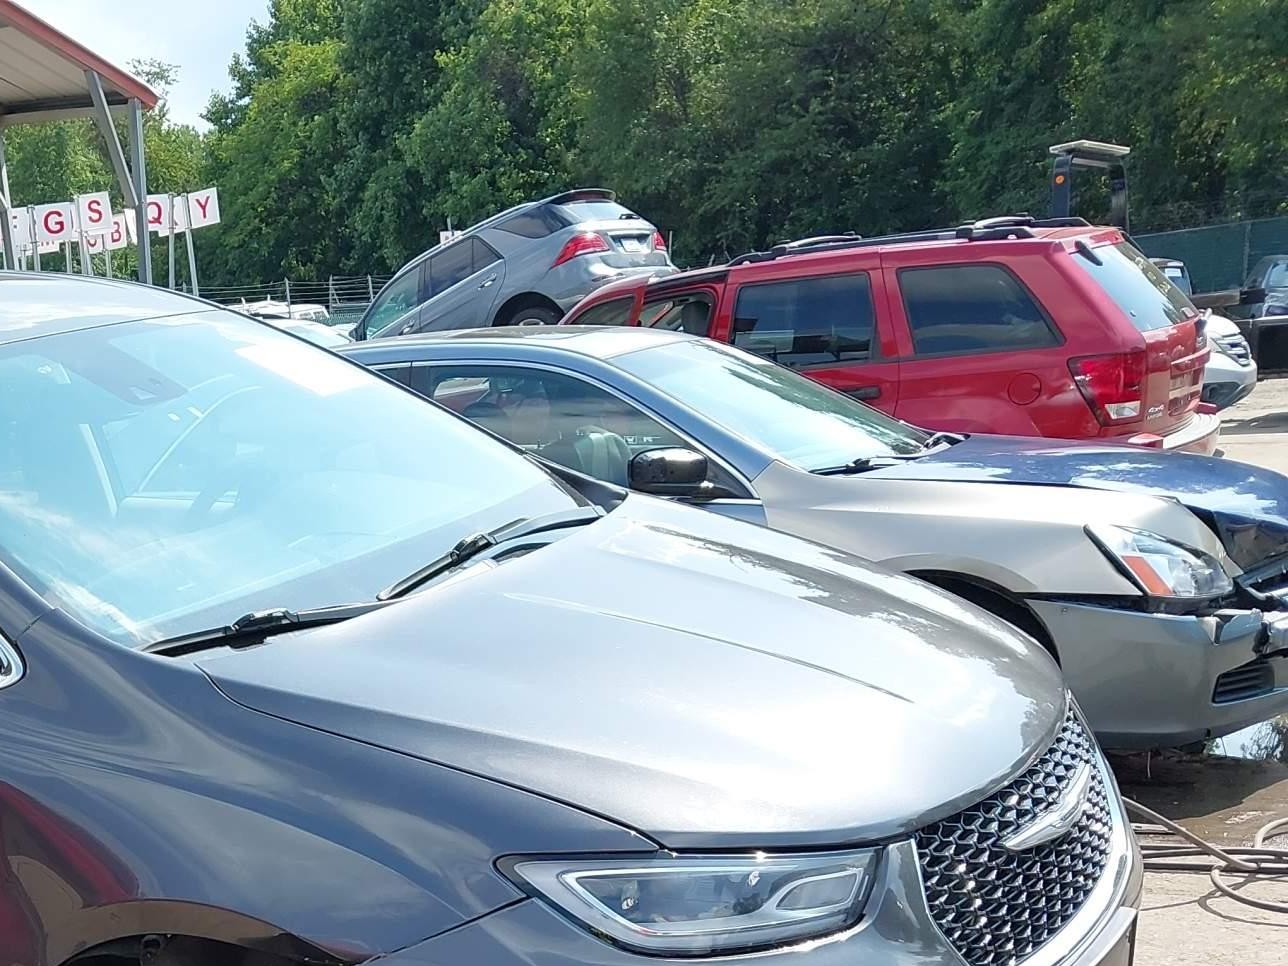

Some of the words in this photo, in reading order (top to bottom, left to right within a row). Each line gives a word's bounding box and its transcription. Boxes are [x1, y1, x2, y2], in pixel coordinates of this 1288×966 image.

[87, 199, 103, 224] S
[147, 201, 163, 225] Q
[195, 195, 211, 220] Y
[43, 210, 65, 235] G
